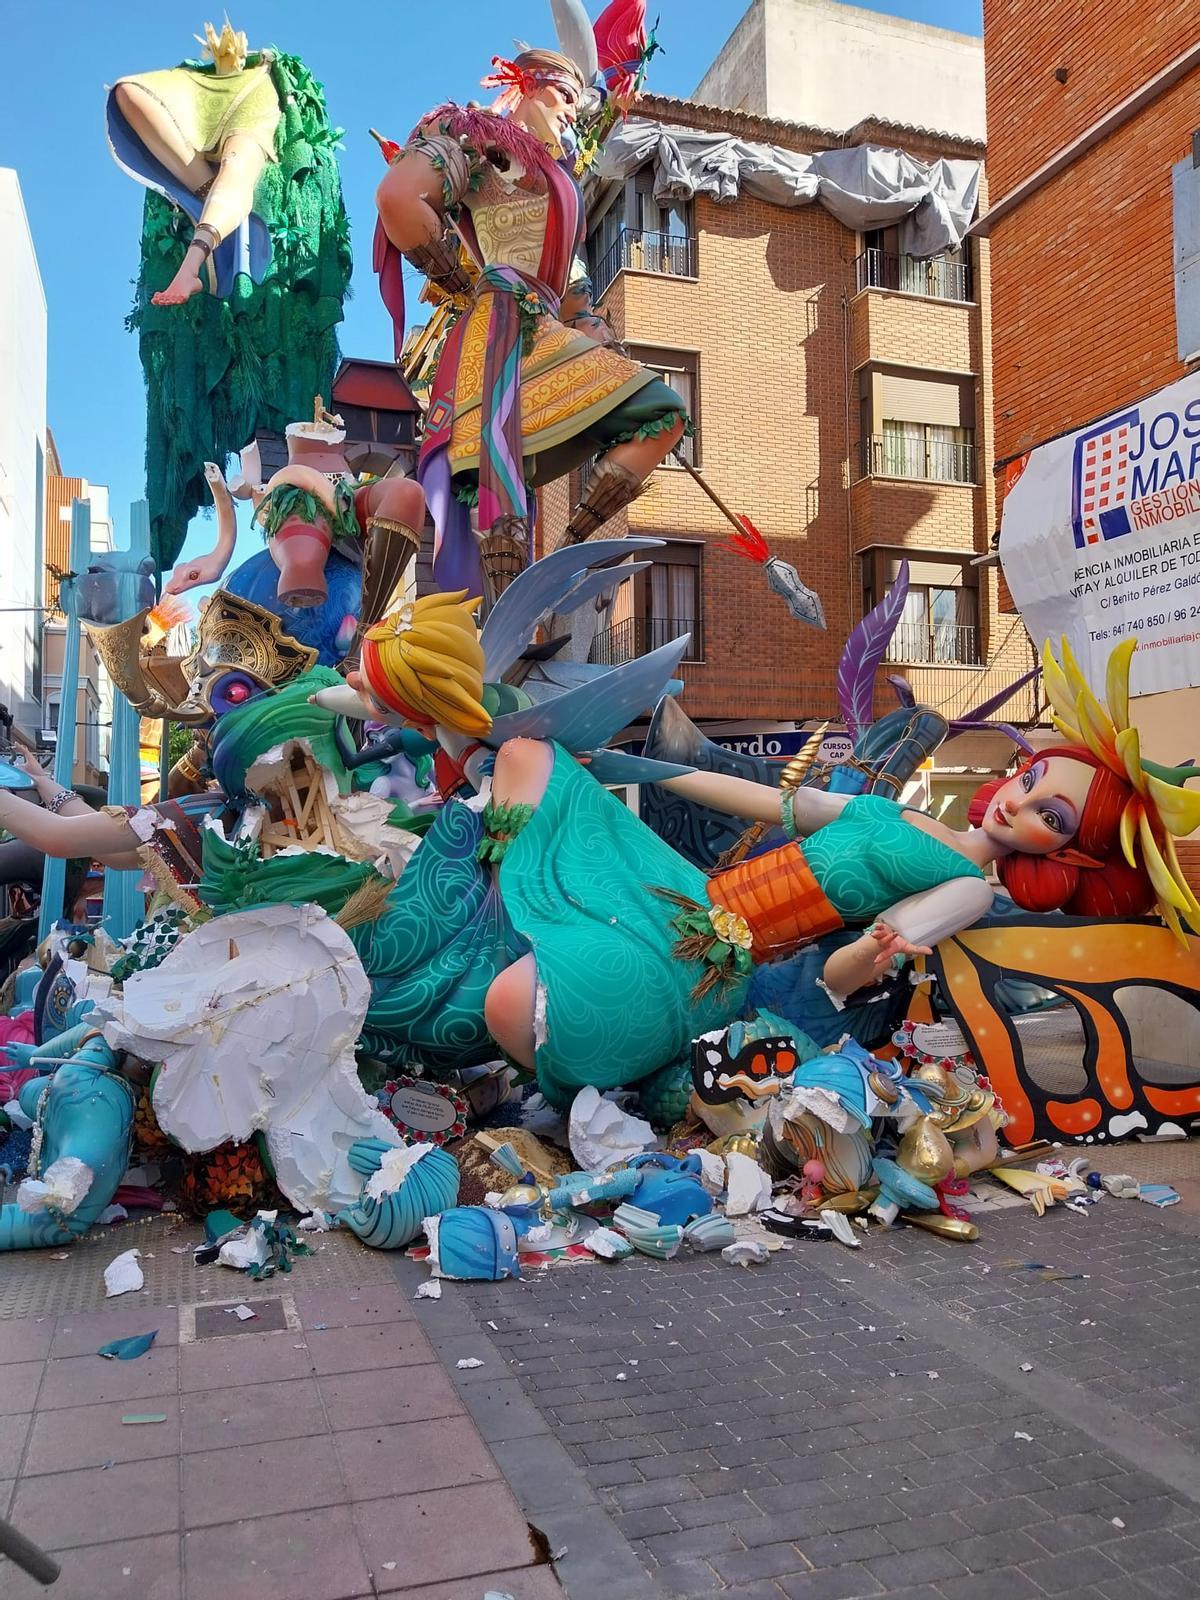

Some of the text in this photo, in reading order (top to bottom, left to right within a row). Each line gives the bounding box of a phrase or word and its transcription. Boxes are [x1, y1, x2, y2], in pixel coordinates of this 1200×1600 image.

[1114, 537, 1192, 570] INMOBILIARIA
[1104, 564, 1158, 589] ALQUILER
[1161, 558, 1177, 573] DE
[1113, 591, 1139, 606] Benito
[1143, 583, 1171, 598] Pérez
[1128, 618, 1144, 632] 740
[1147, 613, 1165, 628] 850
[1173, 608, 1187, 621] 96
[830, 751, 845, 759] CAP
